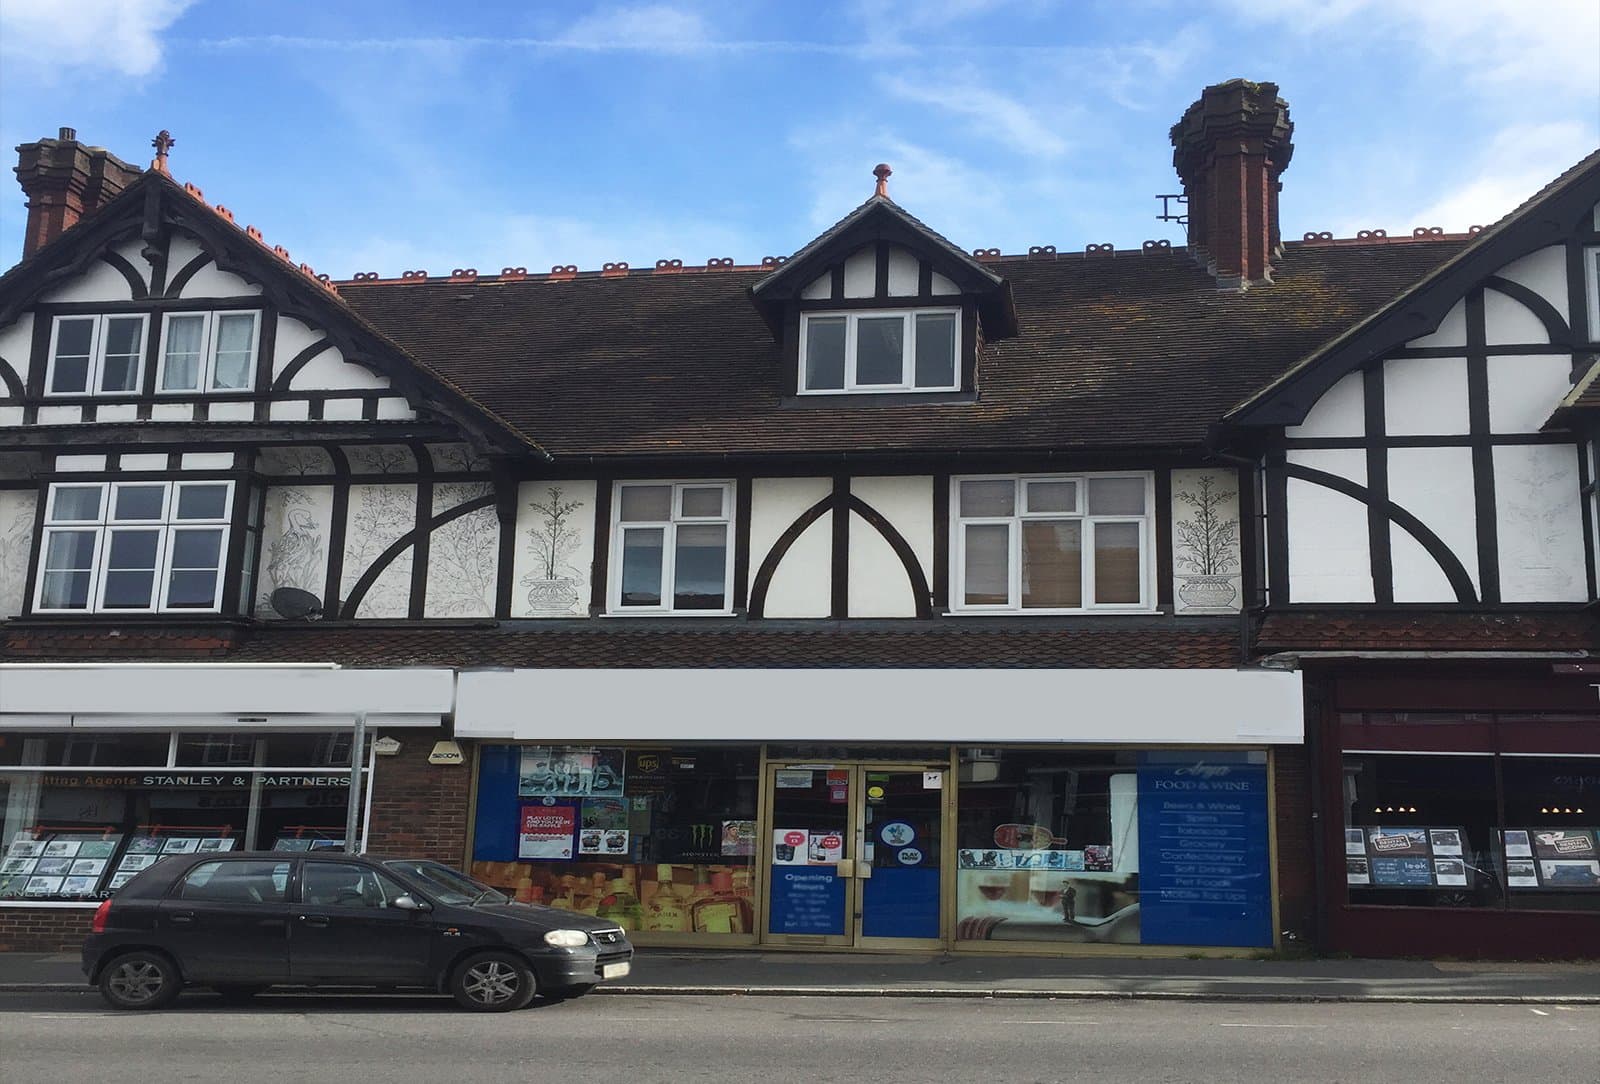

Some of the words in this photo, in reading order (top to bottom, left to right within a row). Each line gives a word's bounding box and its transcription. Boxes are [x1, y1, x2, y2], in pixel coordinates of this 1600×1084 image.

[640, 759, 657, 770] ups
[143, 776, 224, 786] STANLEY
[232, 776, 246, 786] &
[255, 776, 351, 787] PARTNERS
[1155, 780, 1197, 790] FOOD
[1198, 781, 1209, 790] &
[1211, 781, 1250, 791] WINE
[785, 873, 833, 884] Opening
[792, 883, 825, 891] Hours
